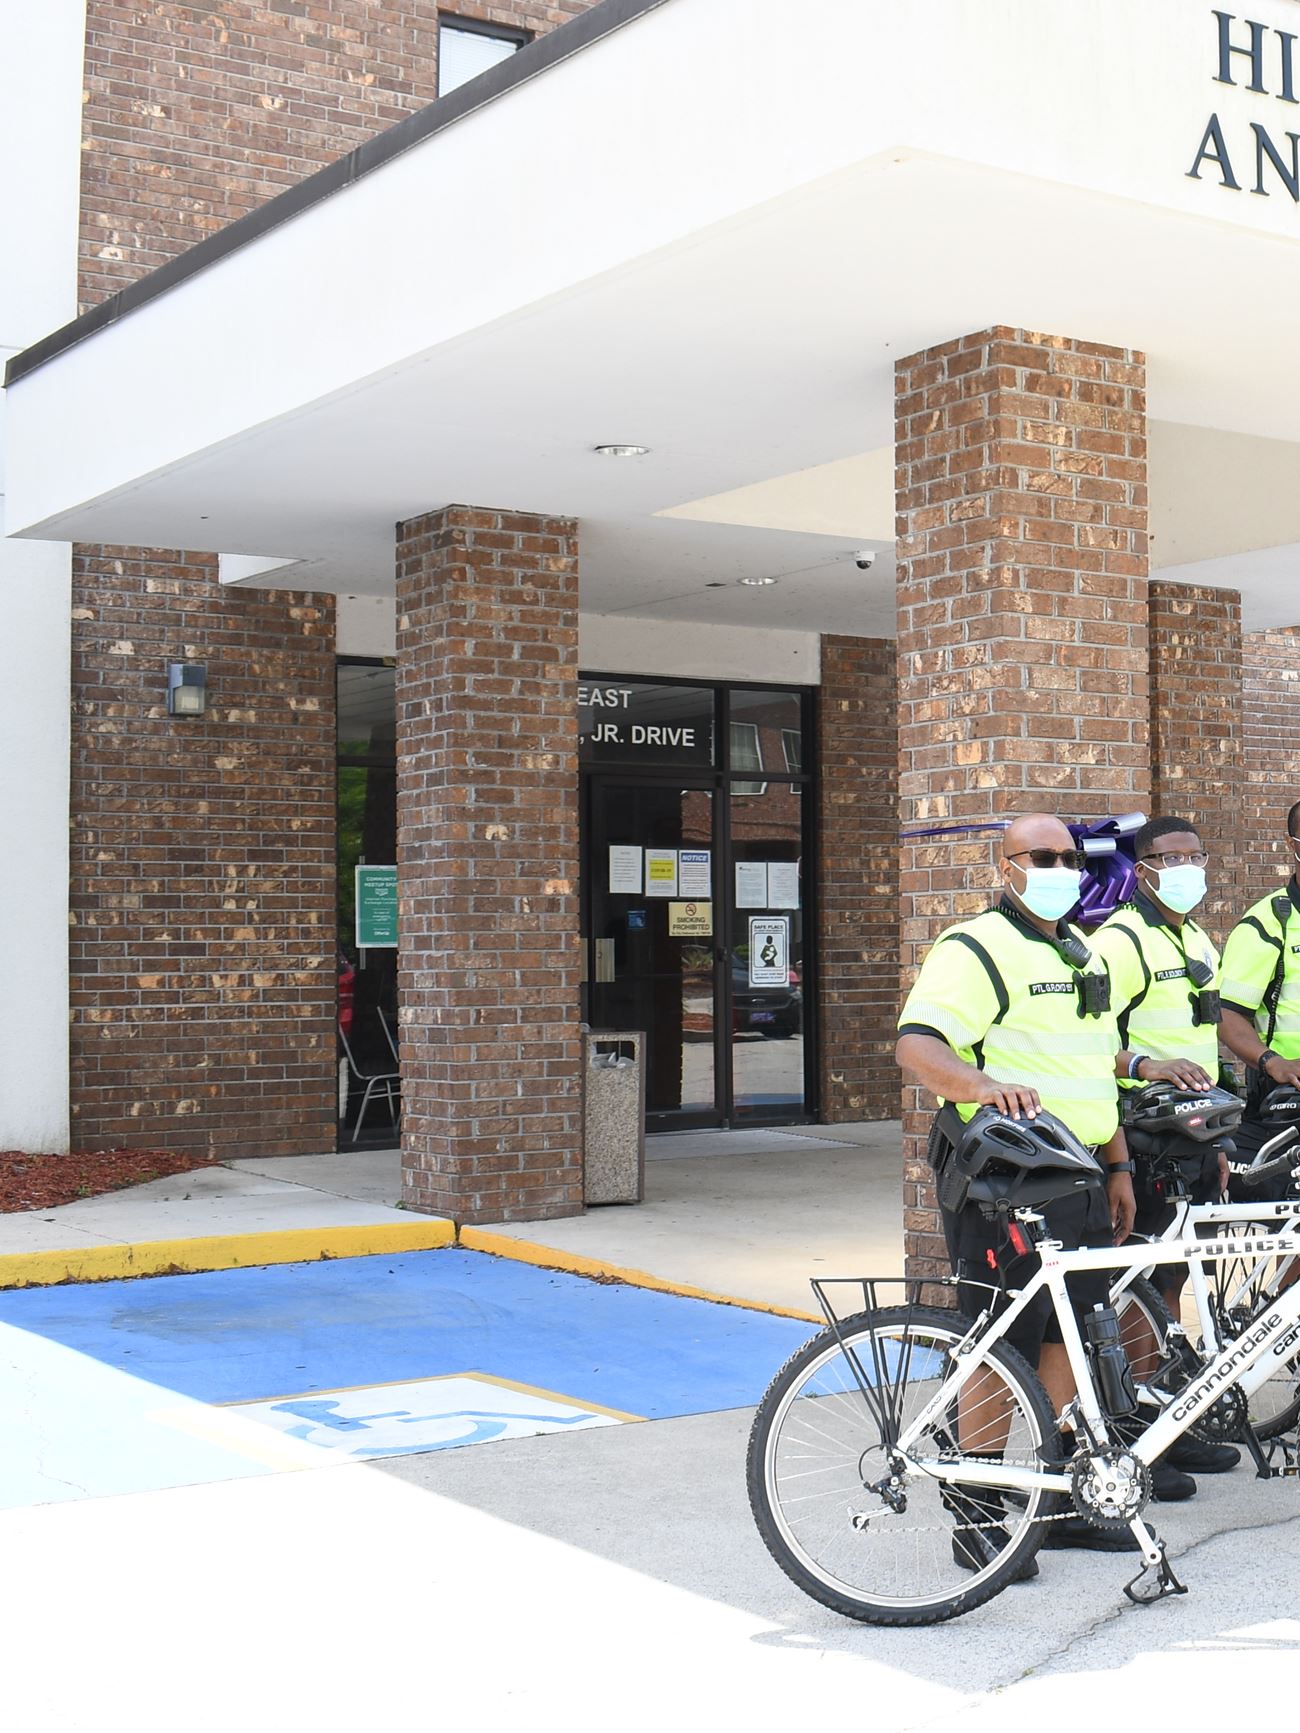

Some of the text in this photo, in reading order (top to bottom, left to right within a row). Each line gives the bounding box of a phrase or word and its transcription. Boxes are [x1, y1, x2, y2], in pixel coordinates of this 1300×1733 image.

[577, 687, 632, 708] EAST
[591, 724, 695, 747] JR. DRIVE
[1174, 1099, 1213, 1114] POLICE
[1184, 1239, 1295, 1257] POLICE
[1172, 1312, 1283, 1422] cannondale
